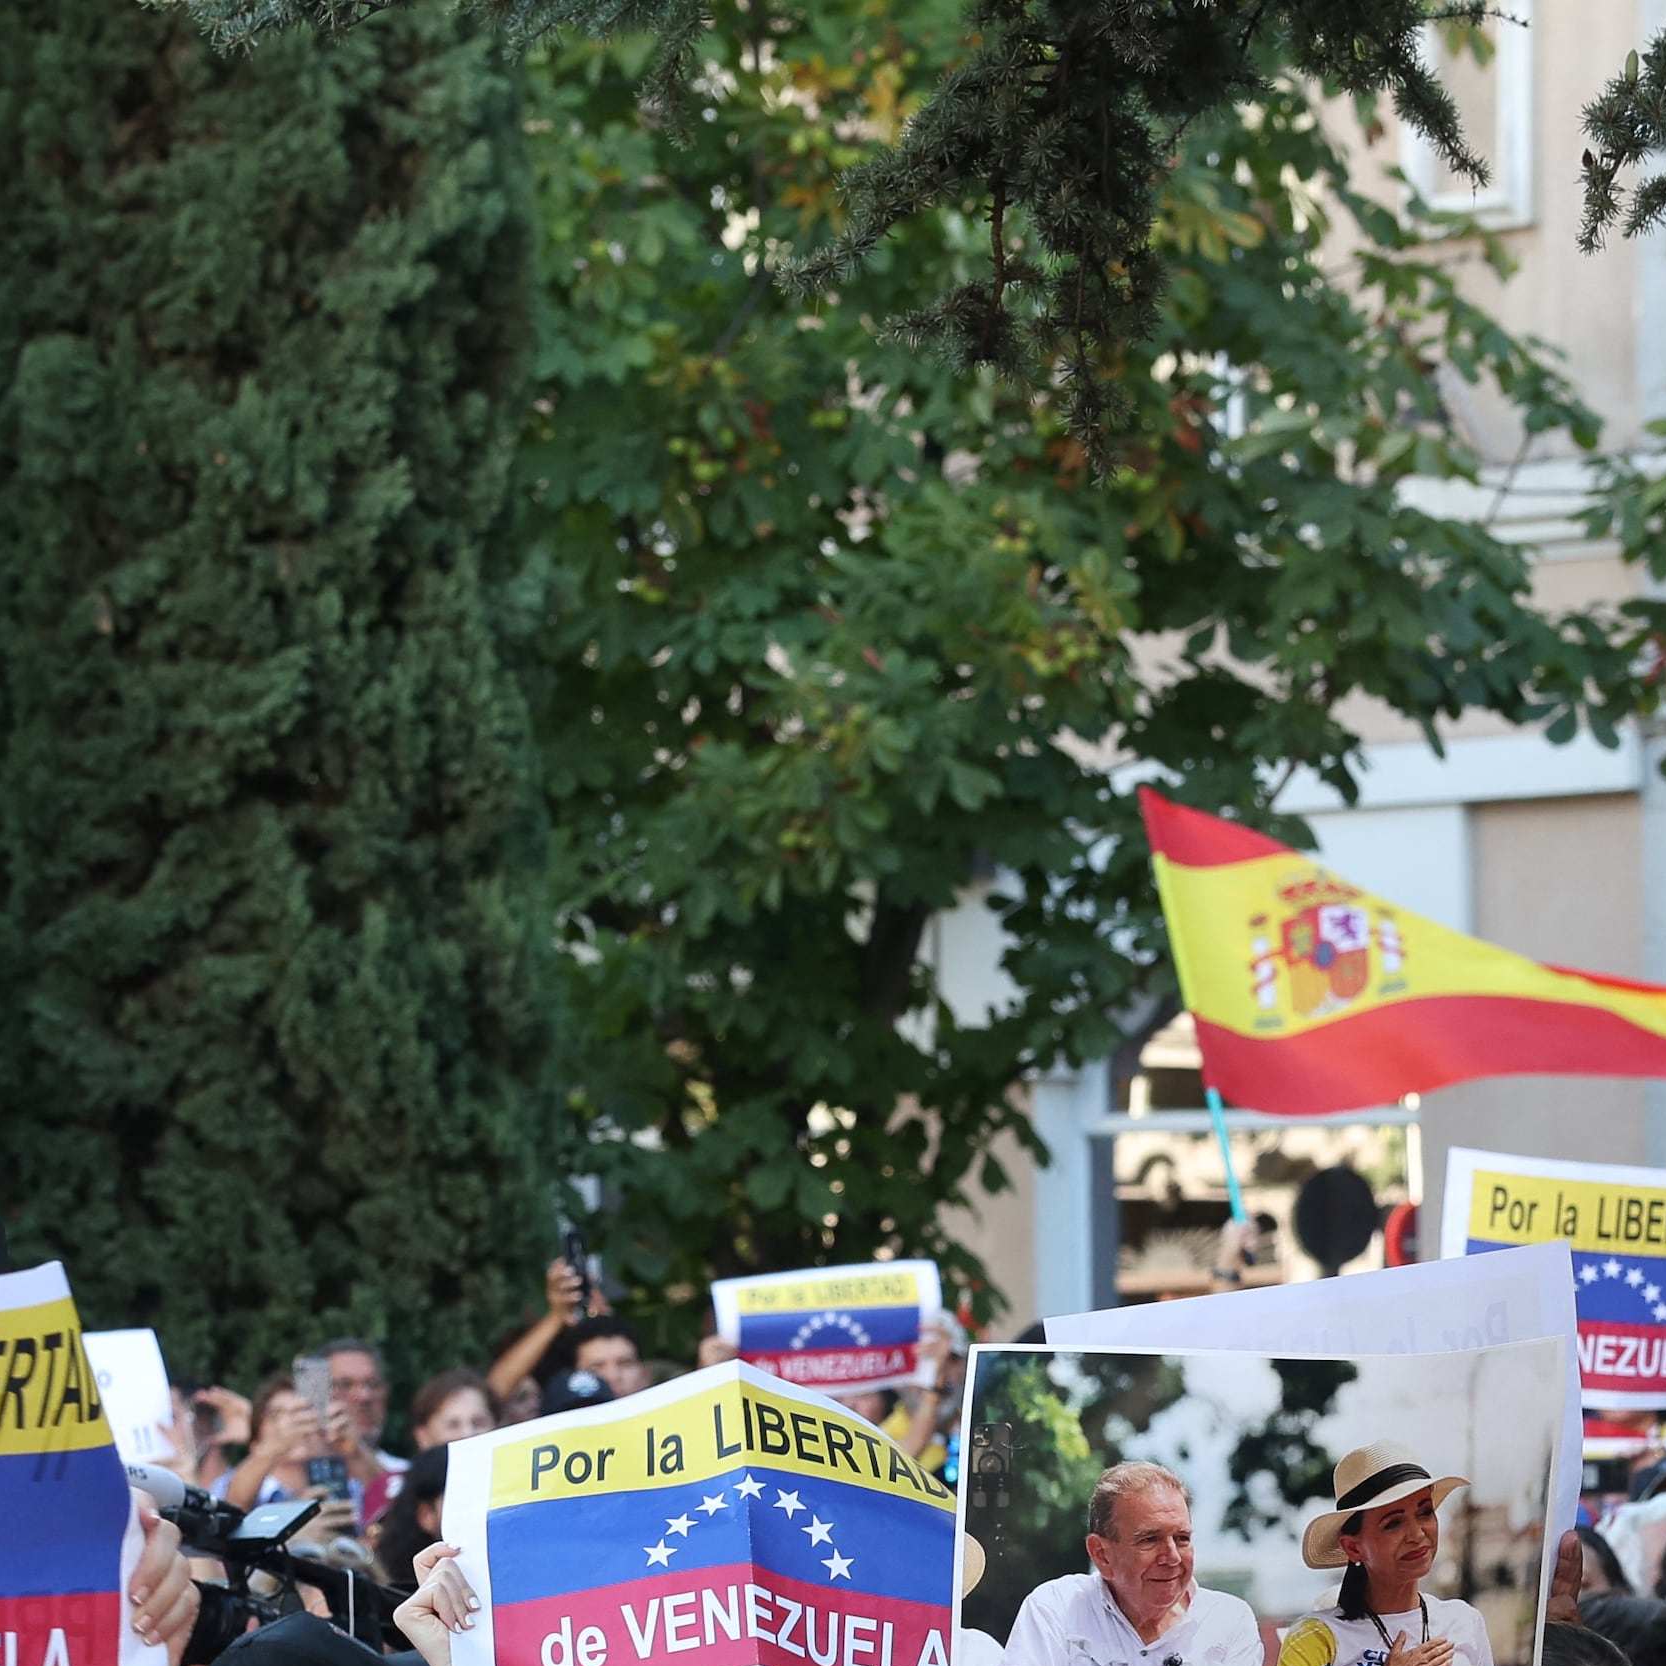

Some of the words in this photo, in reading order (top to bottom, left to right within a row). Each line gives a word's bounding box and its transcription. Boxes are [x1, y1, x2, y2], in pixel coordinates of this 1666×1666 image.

[1490, 1186, 1538, 1233] Por
[1555, 1192, 1578, 1236] la
[813, 1277, 905, 1302] LIBERTAD
[779, 1349, 906, 1381] VENEZUELA
[531, 1444, 615, 1491] Por
[646, 1427, 685, 1477] la
[713, 1397, 949, 1499] LIBERTAD
